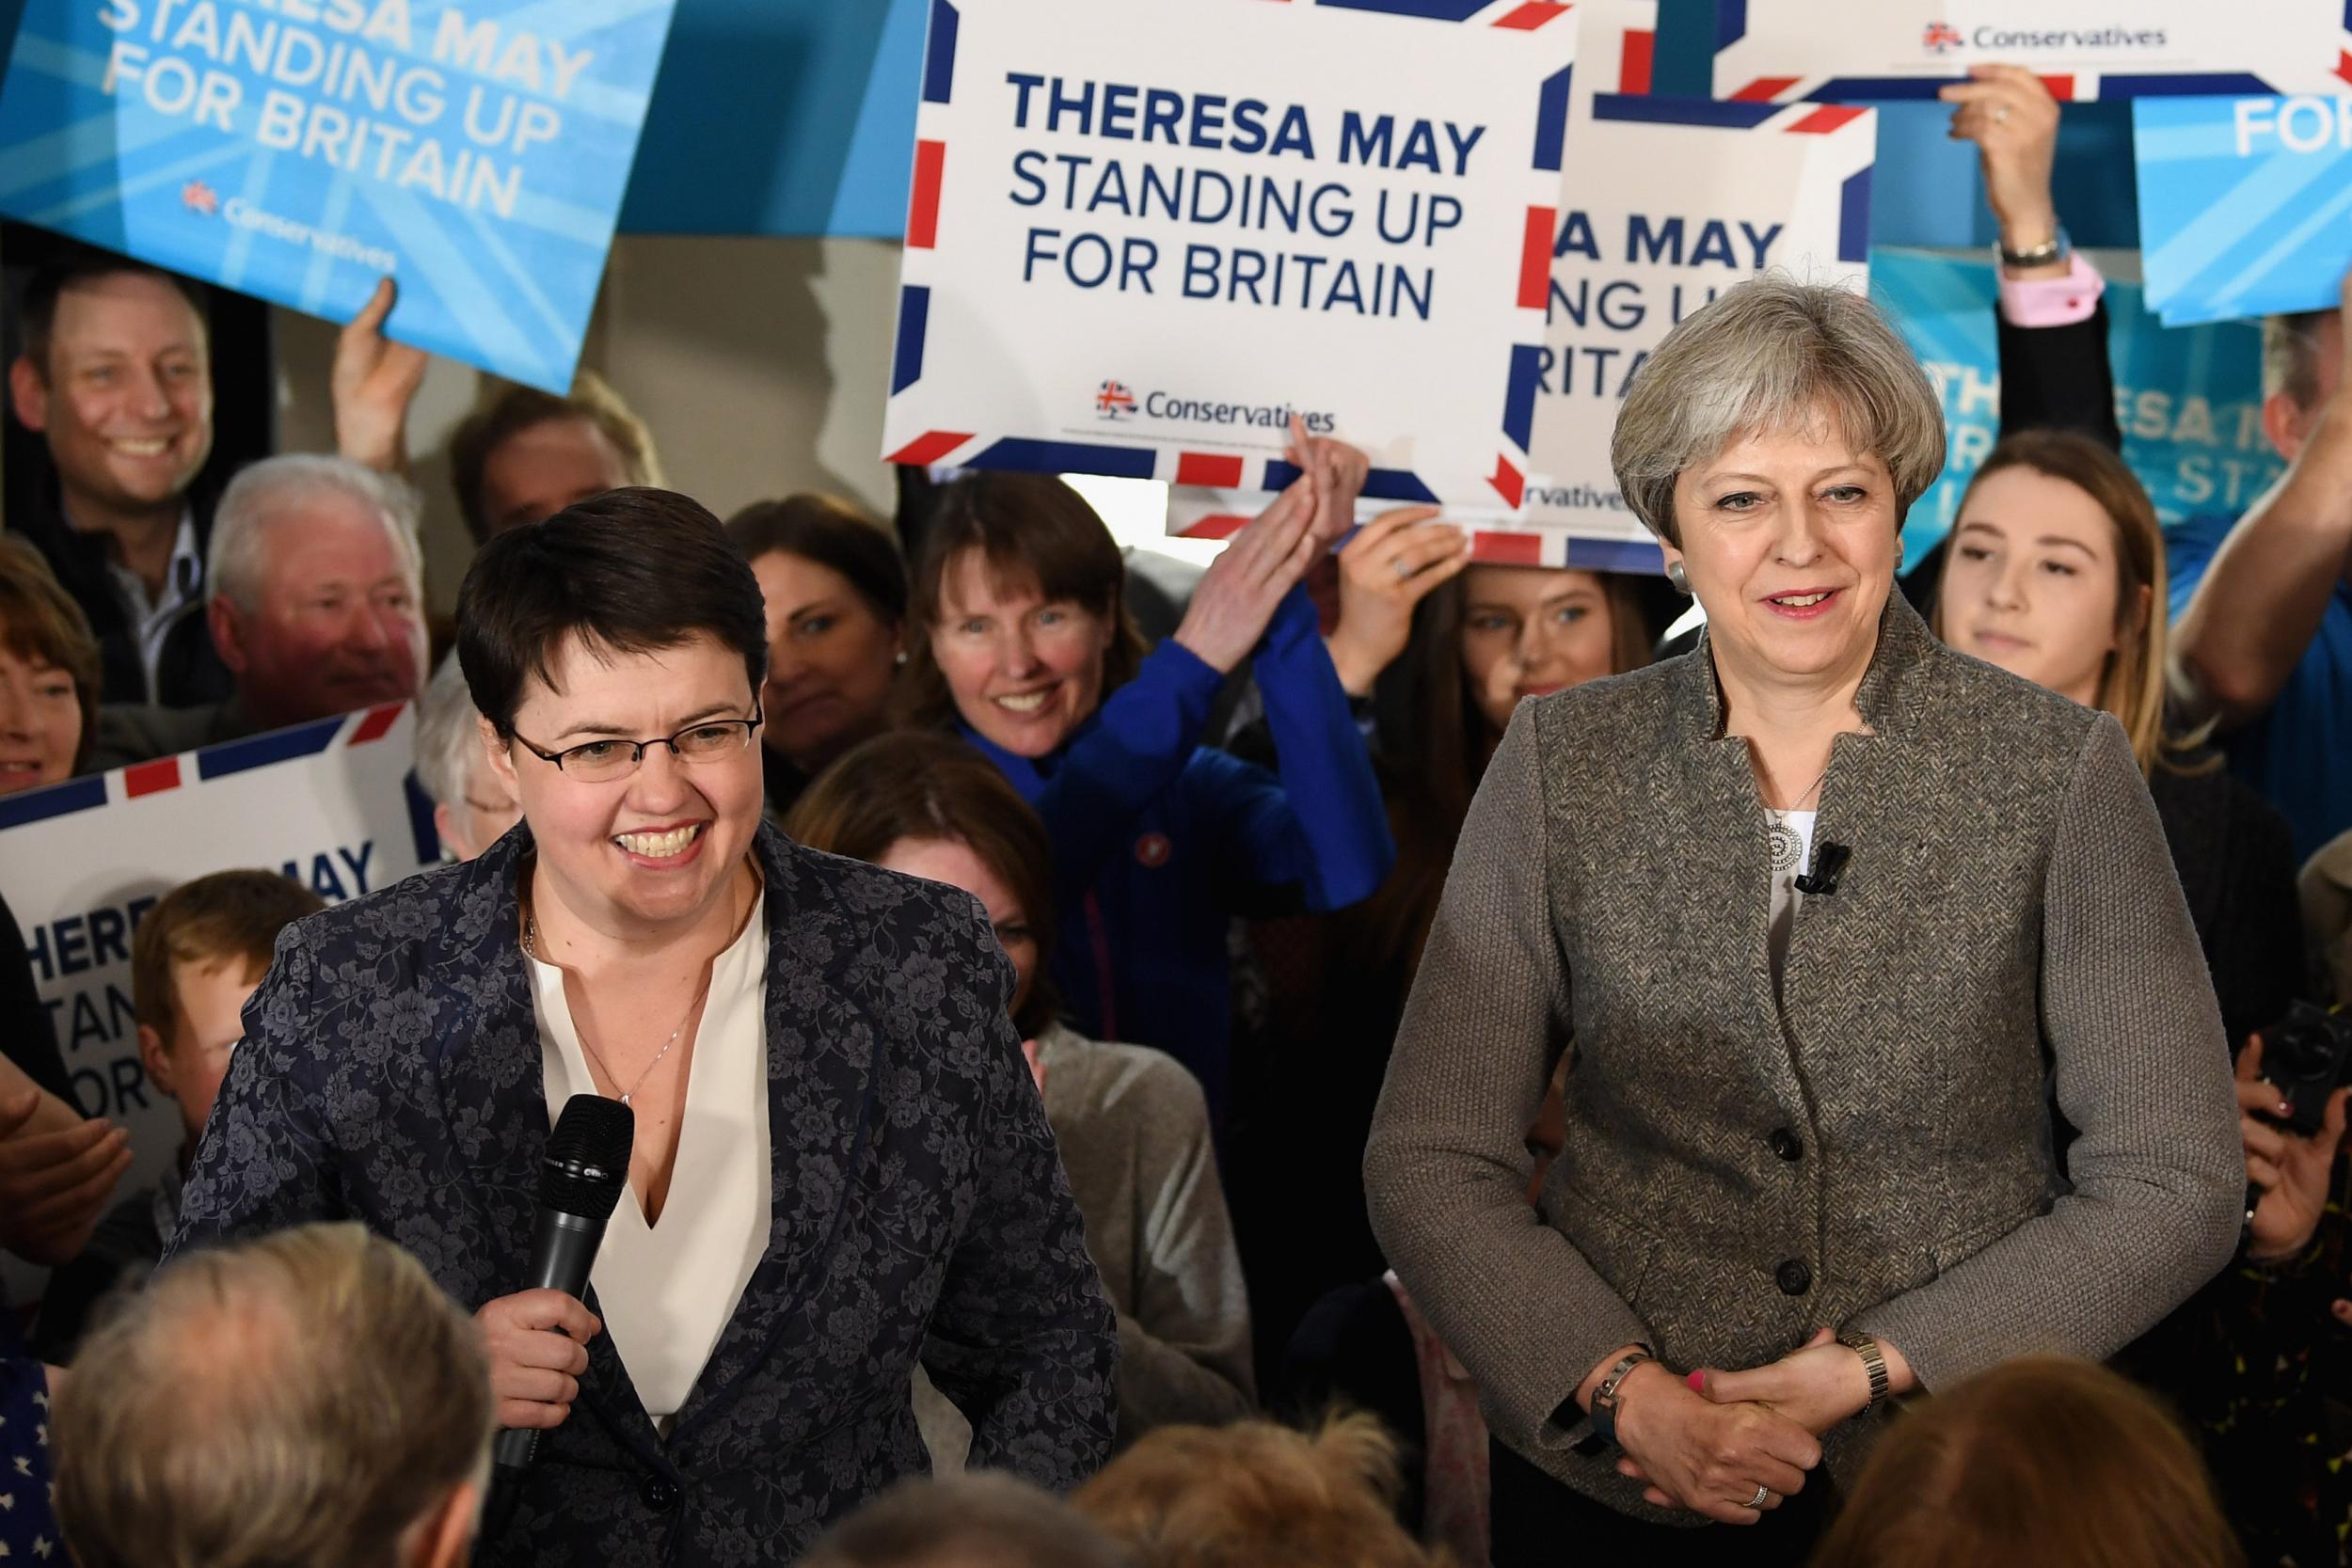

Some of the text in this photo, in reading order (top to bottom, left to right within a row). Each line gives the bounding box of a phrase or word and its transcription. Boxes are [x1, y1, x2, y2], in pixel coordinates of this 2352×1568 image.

[98, 0, 562, 154] STANDING UP
[433, 8, 595, 96] MAY
[1974, 25, 2168, 49] Conservatives
[102, 39, 522, 218] FOR BRITAIN
[1006, 71, 1486, 177] THERESA MAY
[224, 196, 396, 273] Conservatives
[1008, 149, 1463, 247] STANDING UP
[1625, 214, 1784, 269] MAY
[1023, 227, 1435, 322] FOR BRITAIN
[1146, 390, 1336, 433] Conservatives
[281, 840, 373, 900] AY
